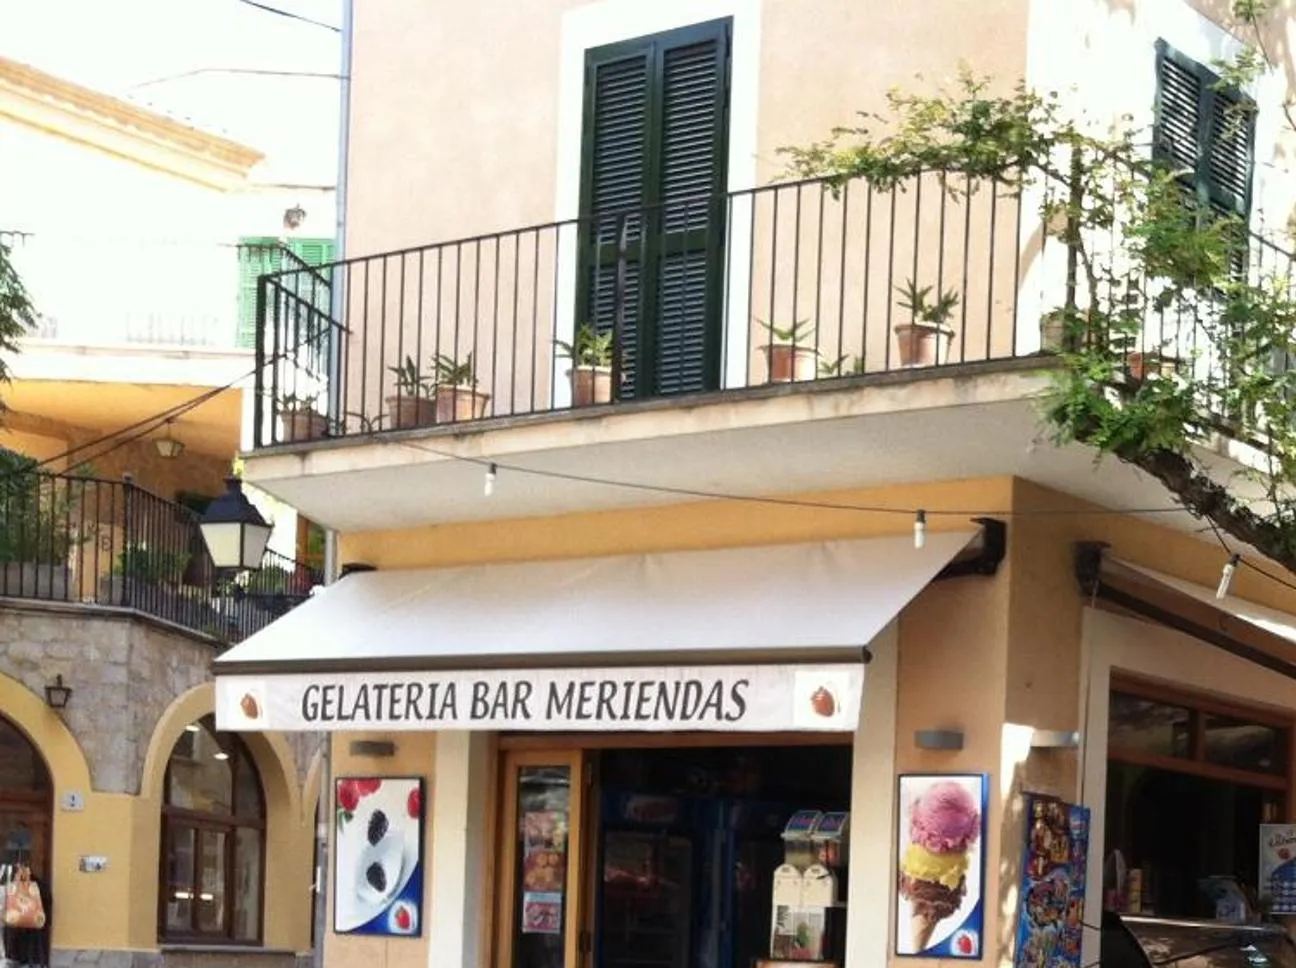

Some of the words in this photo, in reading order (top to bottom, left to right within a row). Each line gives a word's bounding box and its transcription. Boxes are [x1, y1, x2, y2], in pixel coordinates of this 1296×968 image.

[302, 682, 459, 721] GELATERIA
[470, 680, 533, 721] BAR
[545, 679, 750, 721] MERIENDAS
